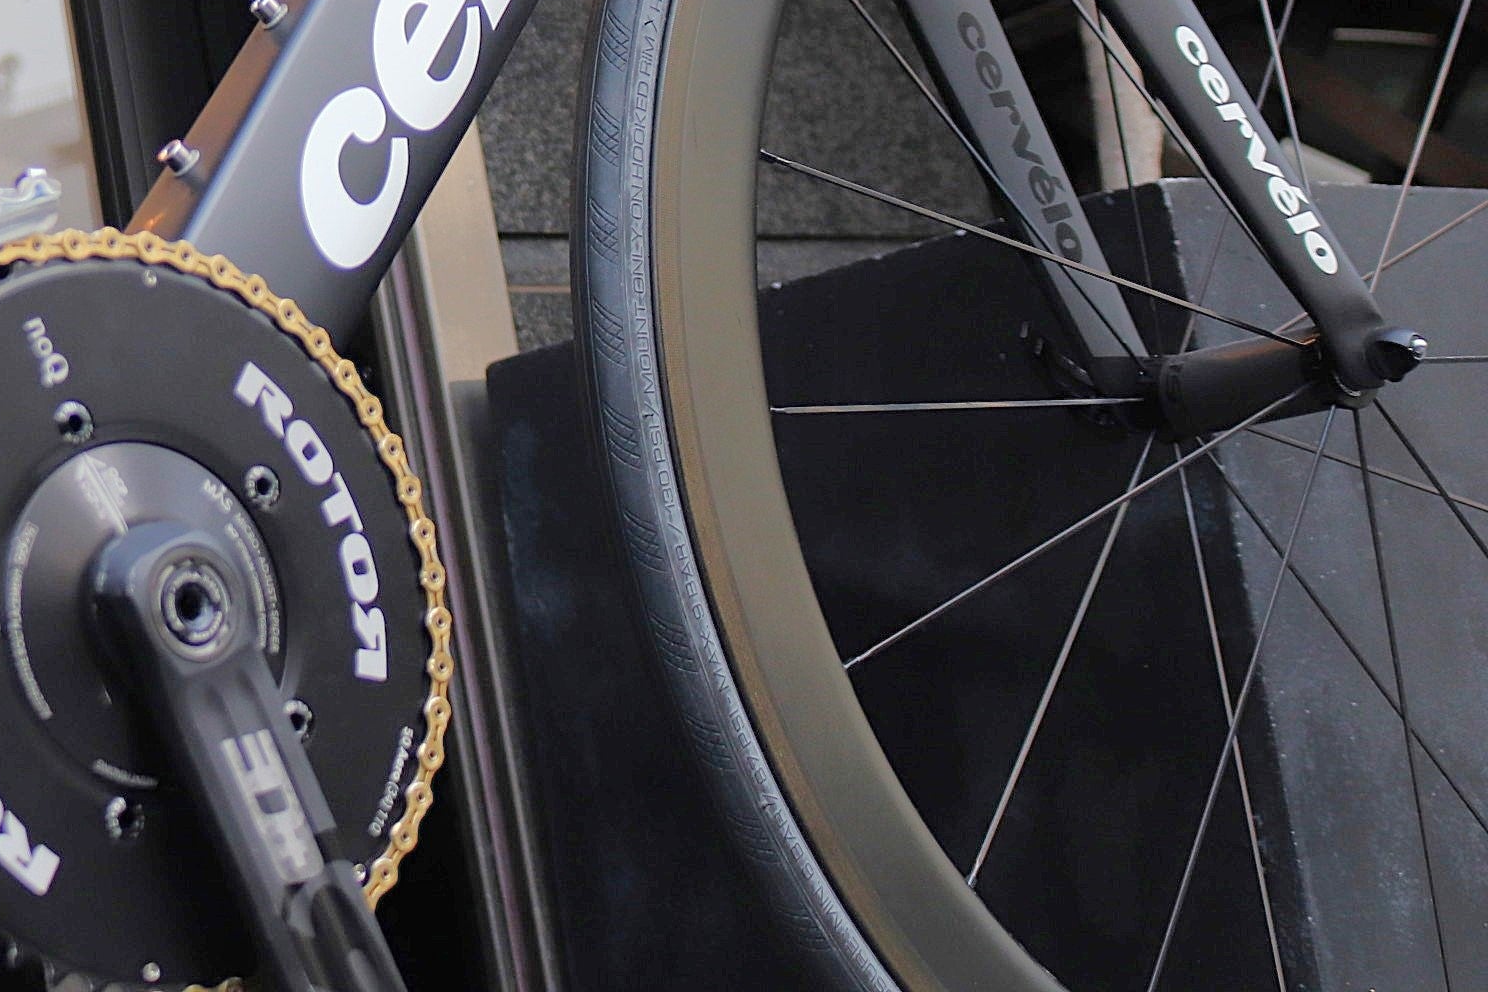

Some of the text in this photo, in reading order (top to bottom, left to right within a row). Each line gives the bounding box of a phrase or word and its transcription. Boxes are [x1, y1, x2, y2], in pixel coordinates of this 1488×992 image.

[640, 37, 655, 76] RIM
[632, 82, 650, 181] HOOKED
[957, 10, 1083, 263] cervélo
[1175, 24, 1339, 275] cervélo
[631, 186, 644, 220] ON
[631, 227, 645, 294] ONLY
[634, 301, 655, 394] MOUNT
[650, 421, 665, 463] PSI
[234, 361, 388, 683] ROTOR
[675, 543, 698, 598] BAR
[729, 709, 752, 751] PSI
[774, 809, 803, 860] BAR
